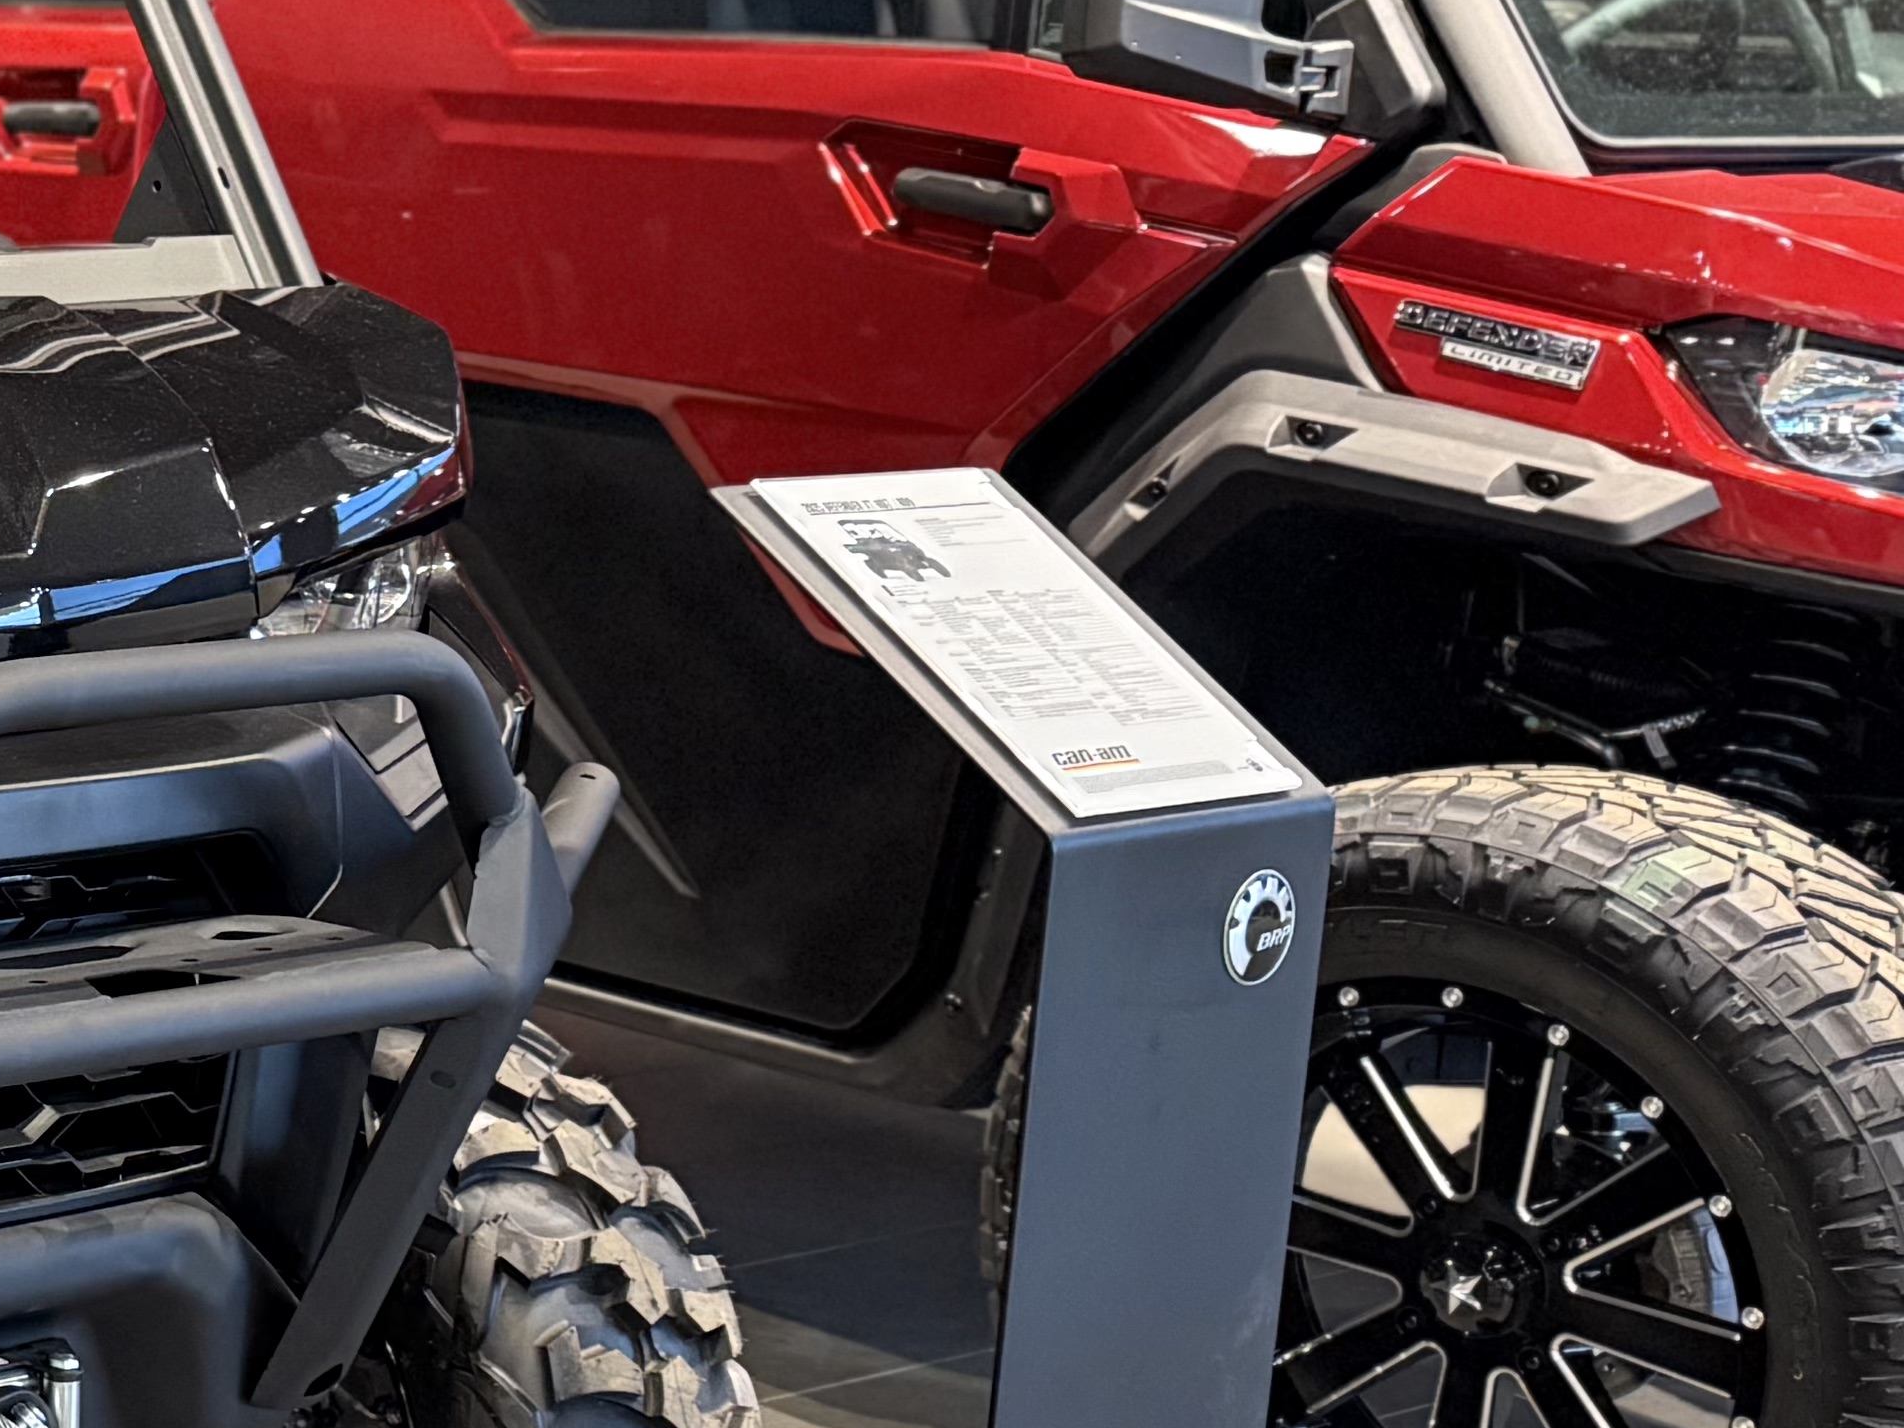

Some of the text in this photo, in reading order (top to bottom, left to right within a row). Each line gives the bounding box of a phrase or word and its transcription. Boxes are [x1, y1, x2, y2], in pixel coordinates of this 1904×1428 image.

[1398, 302, 1600, 368] DEFENDER
[1448, 345, 1577, 384] LIMITED
[1051, 744, 1132, 767] can-am
[1255, 924, 1292, 953] BRP
